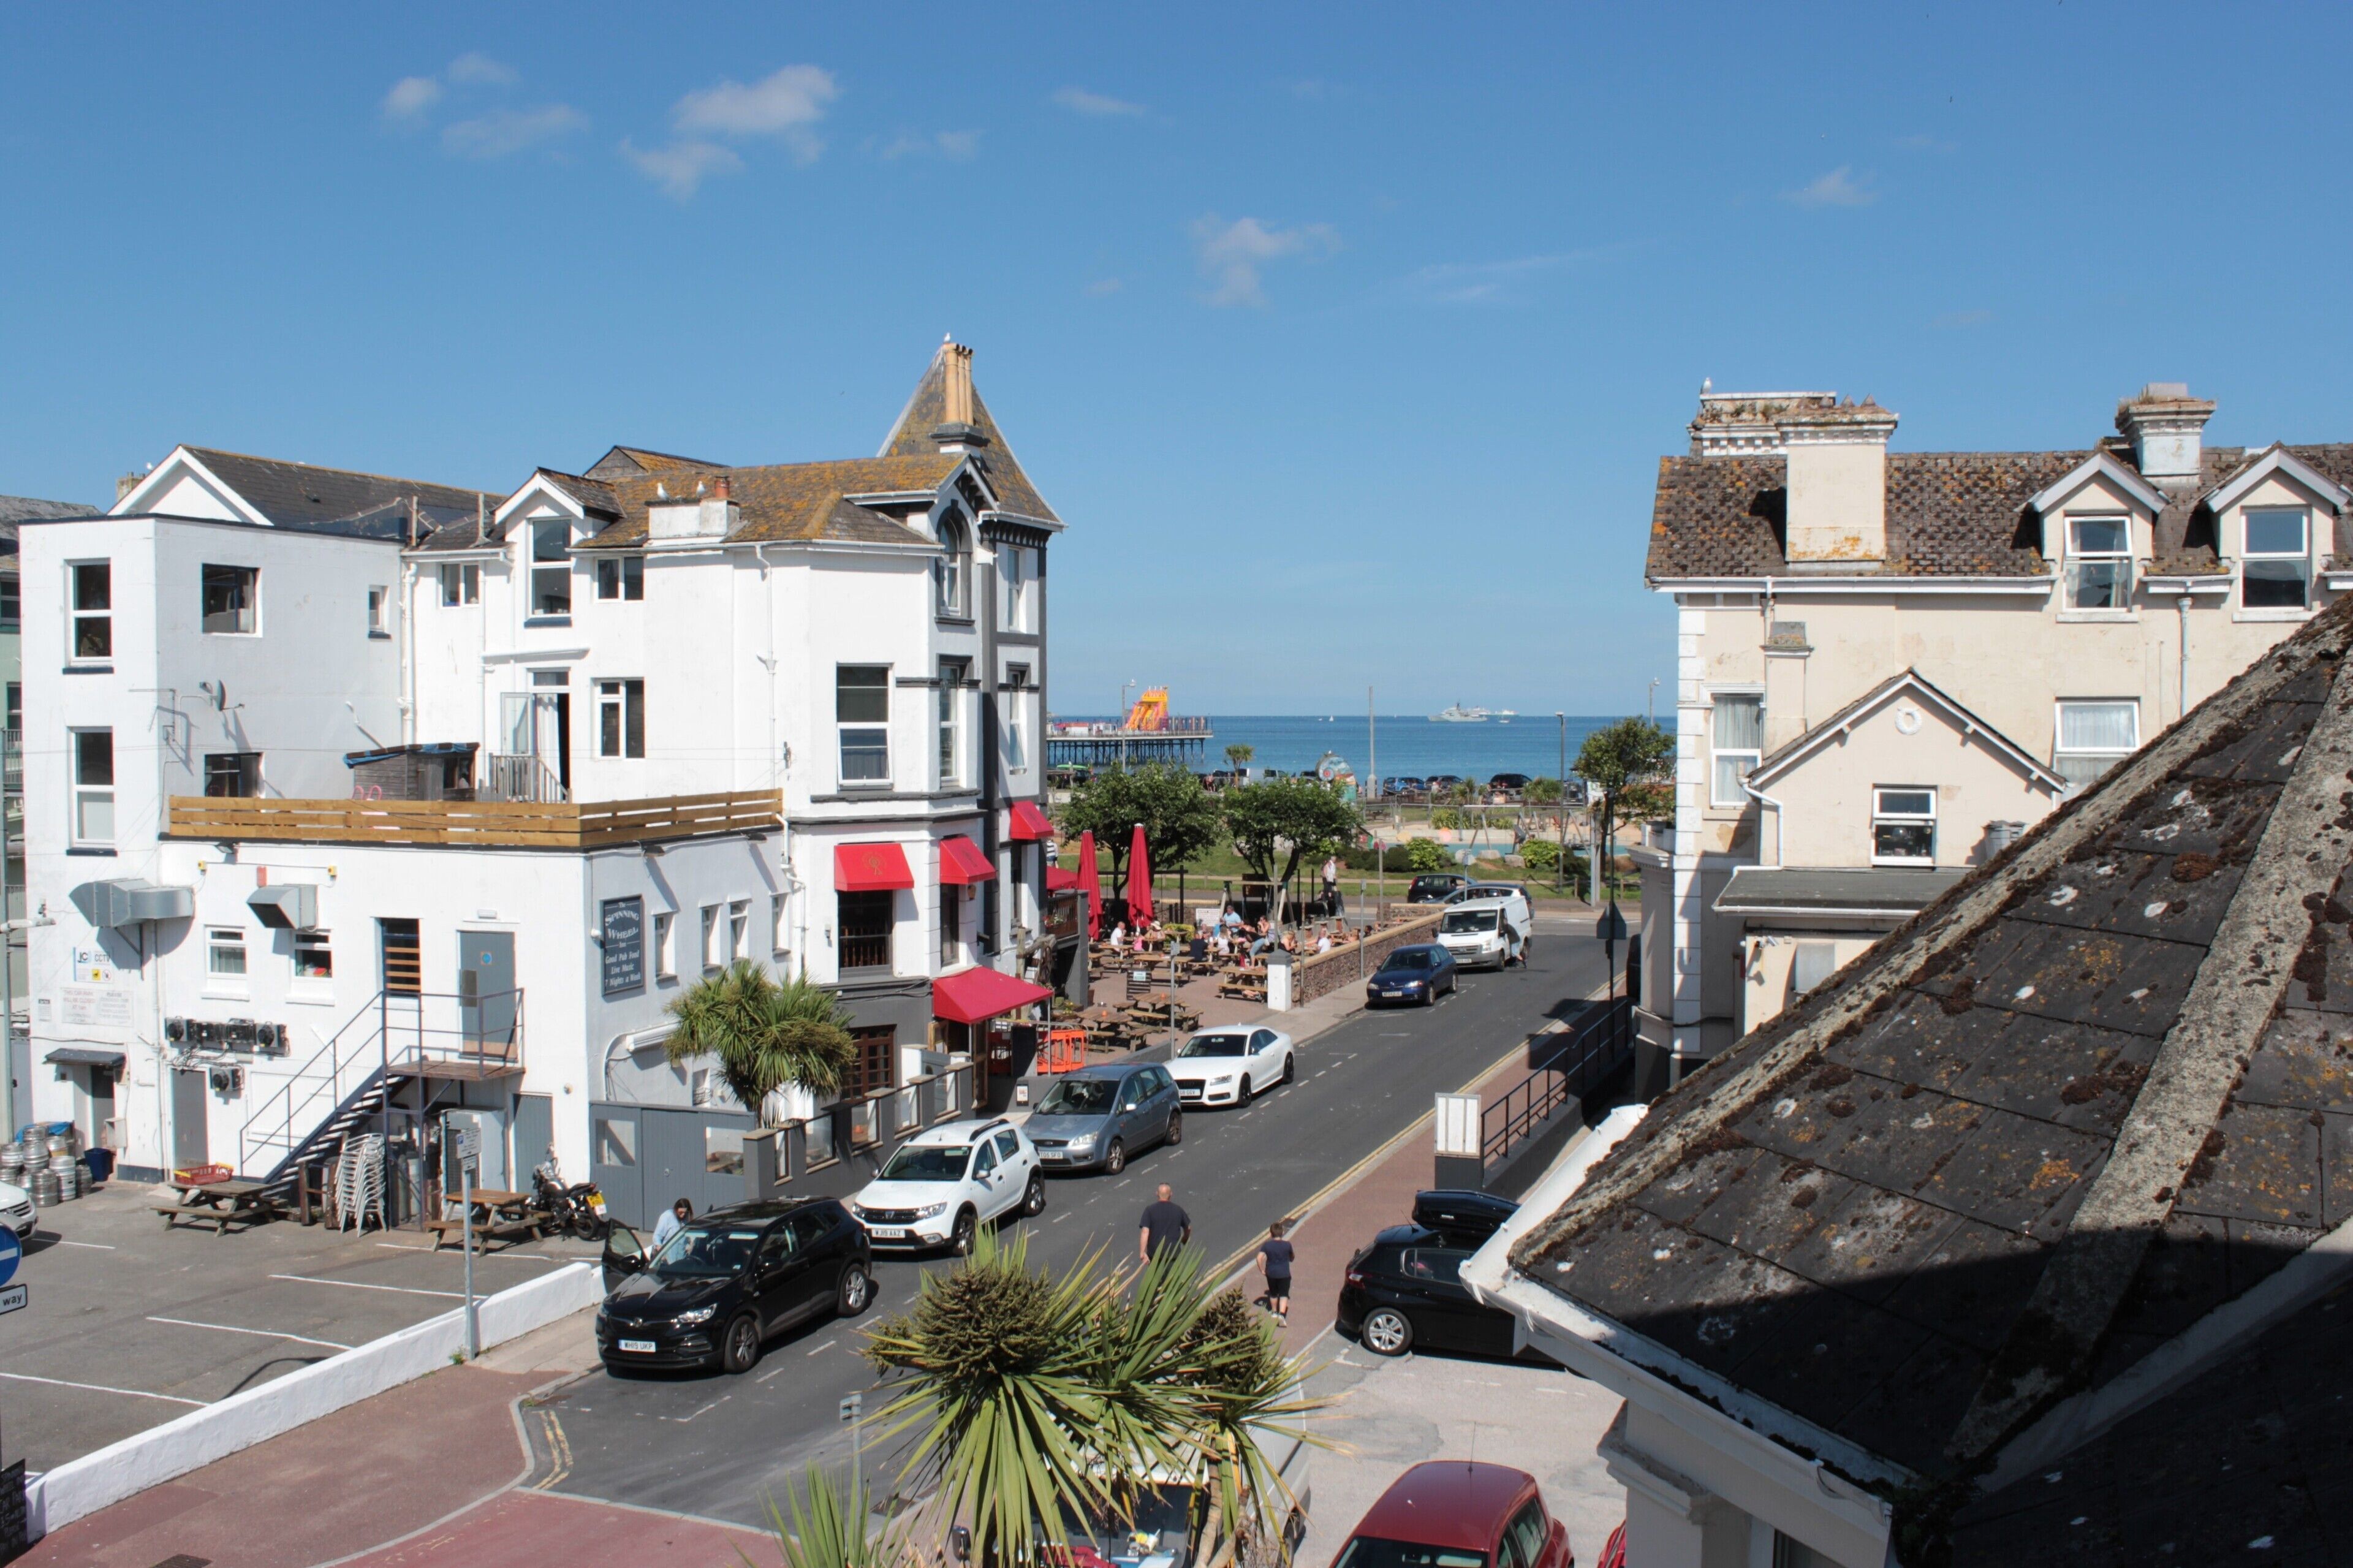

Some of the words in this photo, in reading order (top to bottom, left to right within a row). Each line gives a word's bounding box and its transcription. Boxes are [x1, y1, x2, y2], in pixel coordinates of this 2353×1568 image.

[608, 926, 638, 939] WHEEL
[94, 953, 110, 963] CCTV
[605, 953, 618, 964] Good
[619, 952, 627, 961] Pub
[629, 950, 640, 960] Food
[611, 966, 620, 974] Live
[622, 963, 634, 972] Music
[610, 977, 624, 987] Nights
[630, 972, 641, 981] Week
[3, 1294, 22, 1306] way
